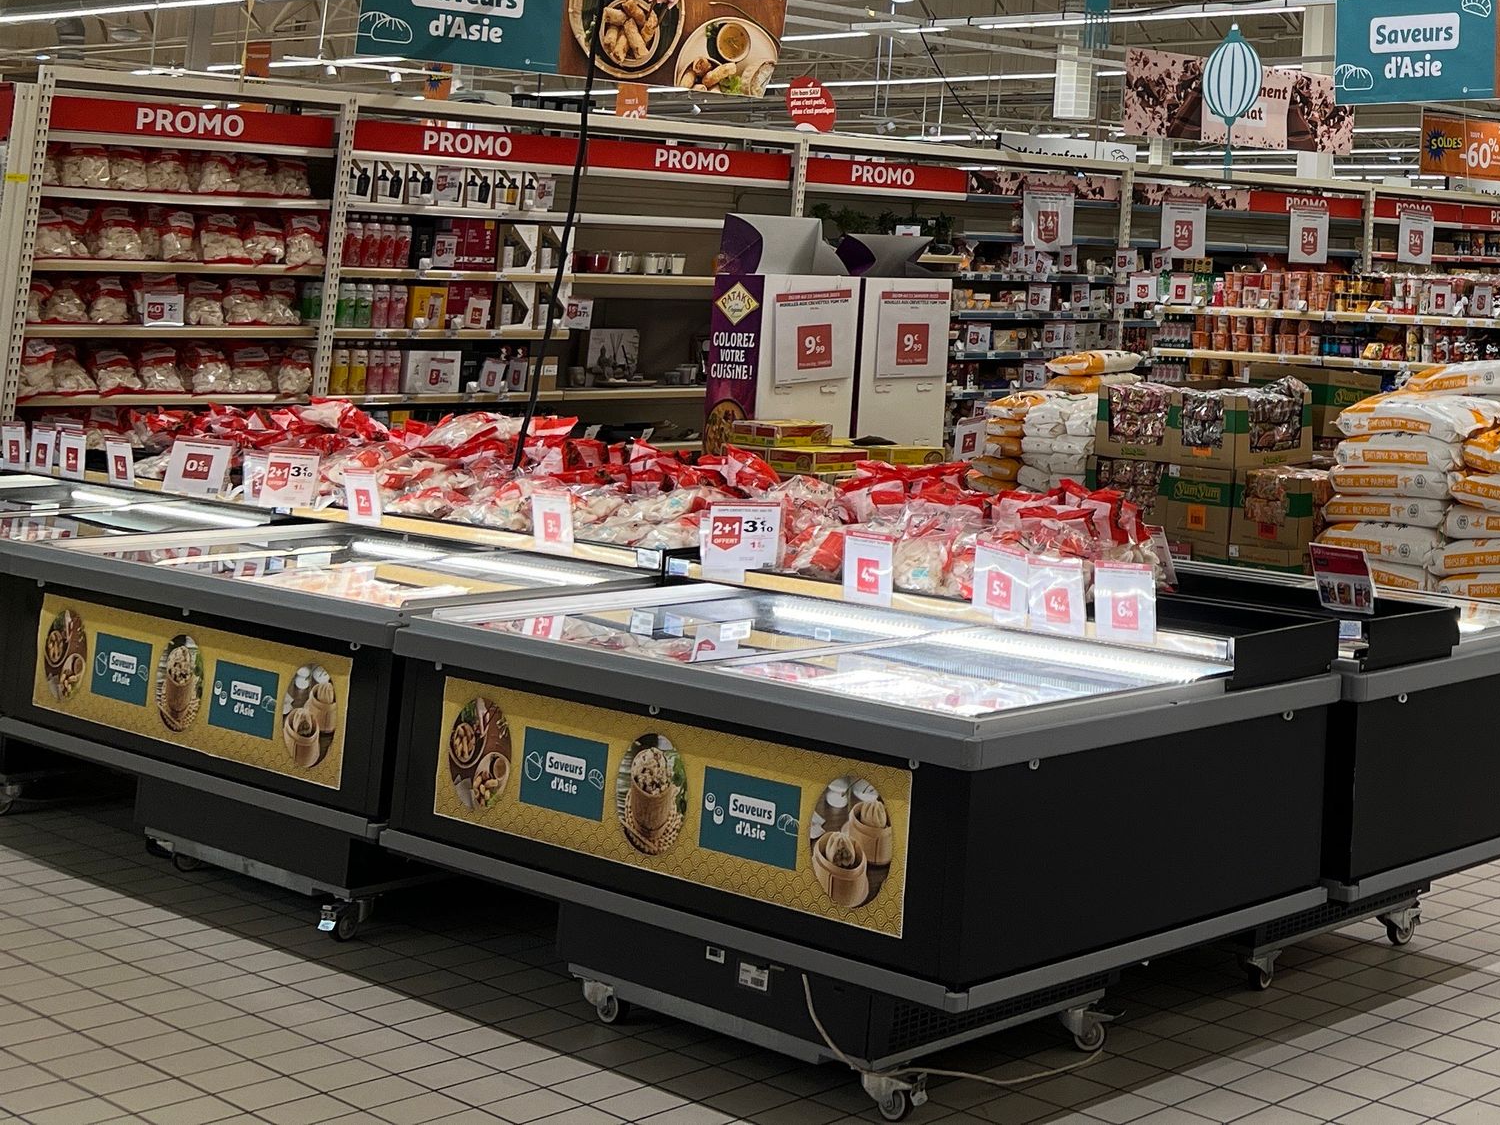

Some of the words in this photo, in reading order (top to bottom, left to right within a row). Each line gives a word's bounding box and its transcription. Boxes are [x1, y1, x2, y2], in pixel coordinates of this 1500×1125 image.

[427, 12, 504, 44] d'Asie
[1375, 23, 1454, 46] Saveurs
[1384, 52, 1443, 79] d'Asie
[136, 107, 245, 138] PROMO
[423, 129, 513, 158] PROMO
[1431, 136, 1463, 150] SOLDES
[655, 148, 730, 173] PROMO
[850, 163, 916, 186] PROMO
[713, 331, 756, 348] COLOREZ
[720, 348, 746, 363] VOTRE
[712, 521, 740, 536] 2+1
[713, 536, 738, 545] OFFERT
[110, 654, 136, 672] Saveurs
[111, 671, 131, 687] d'Asie
[232, 682, 260, 703] Saveurs
[233, 700, 255, 718] d'Asie
[547, 754, 584, 777] Saveurs
[550, 776, 578, 796] d'Asie
[731, 796, 774, 824] Saveurs
[735, 822, 767, 841] d'Asie
